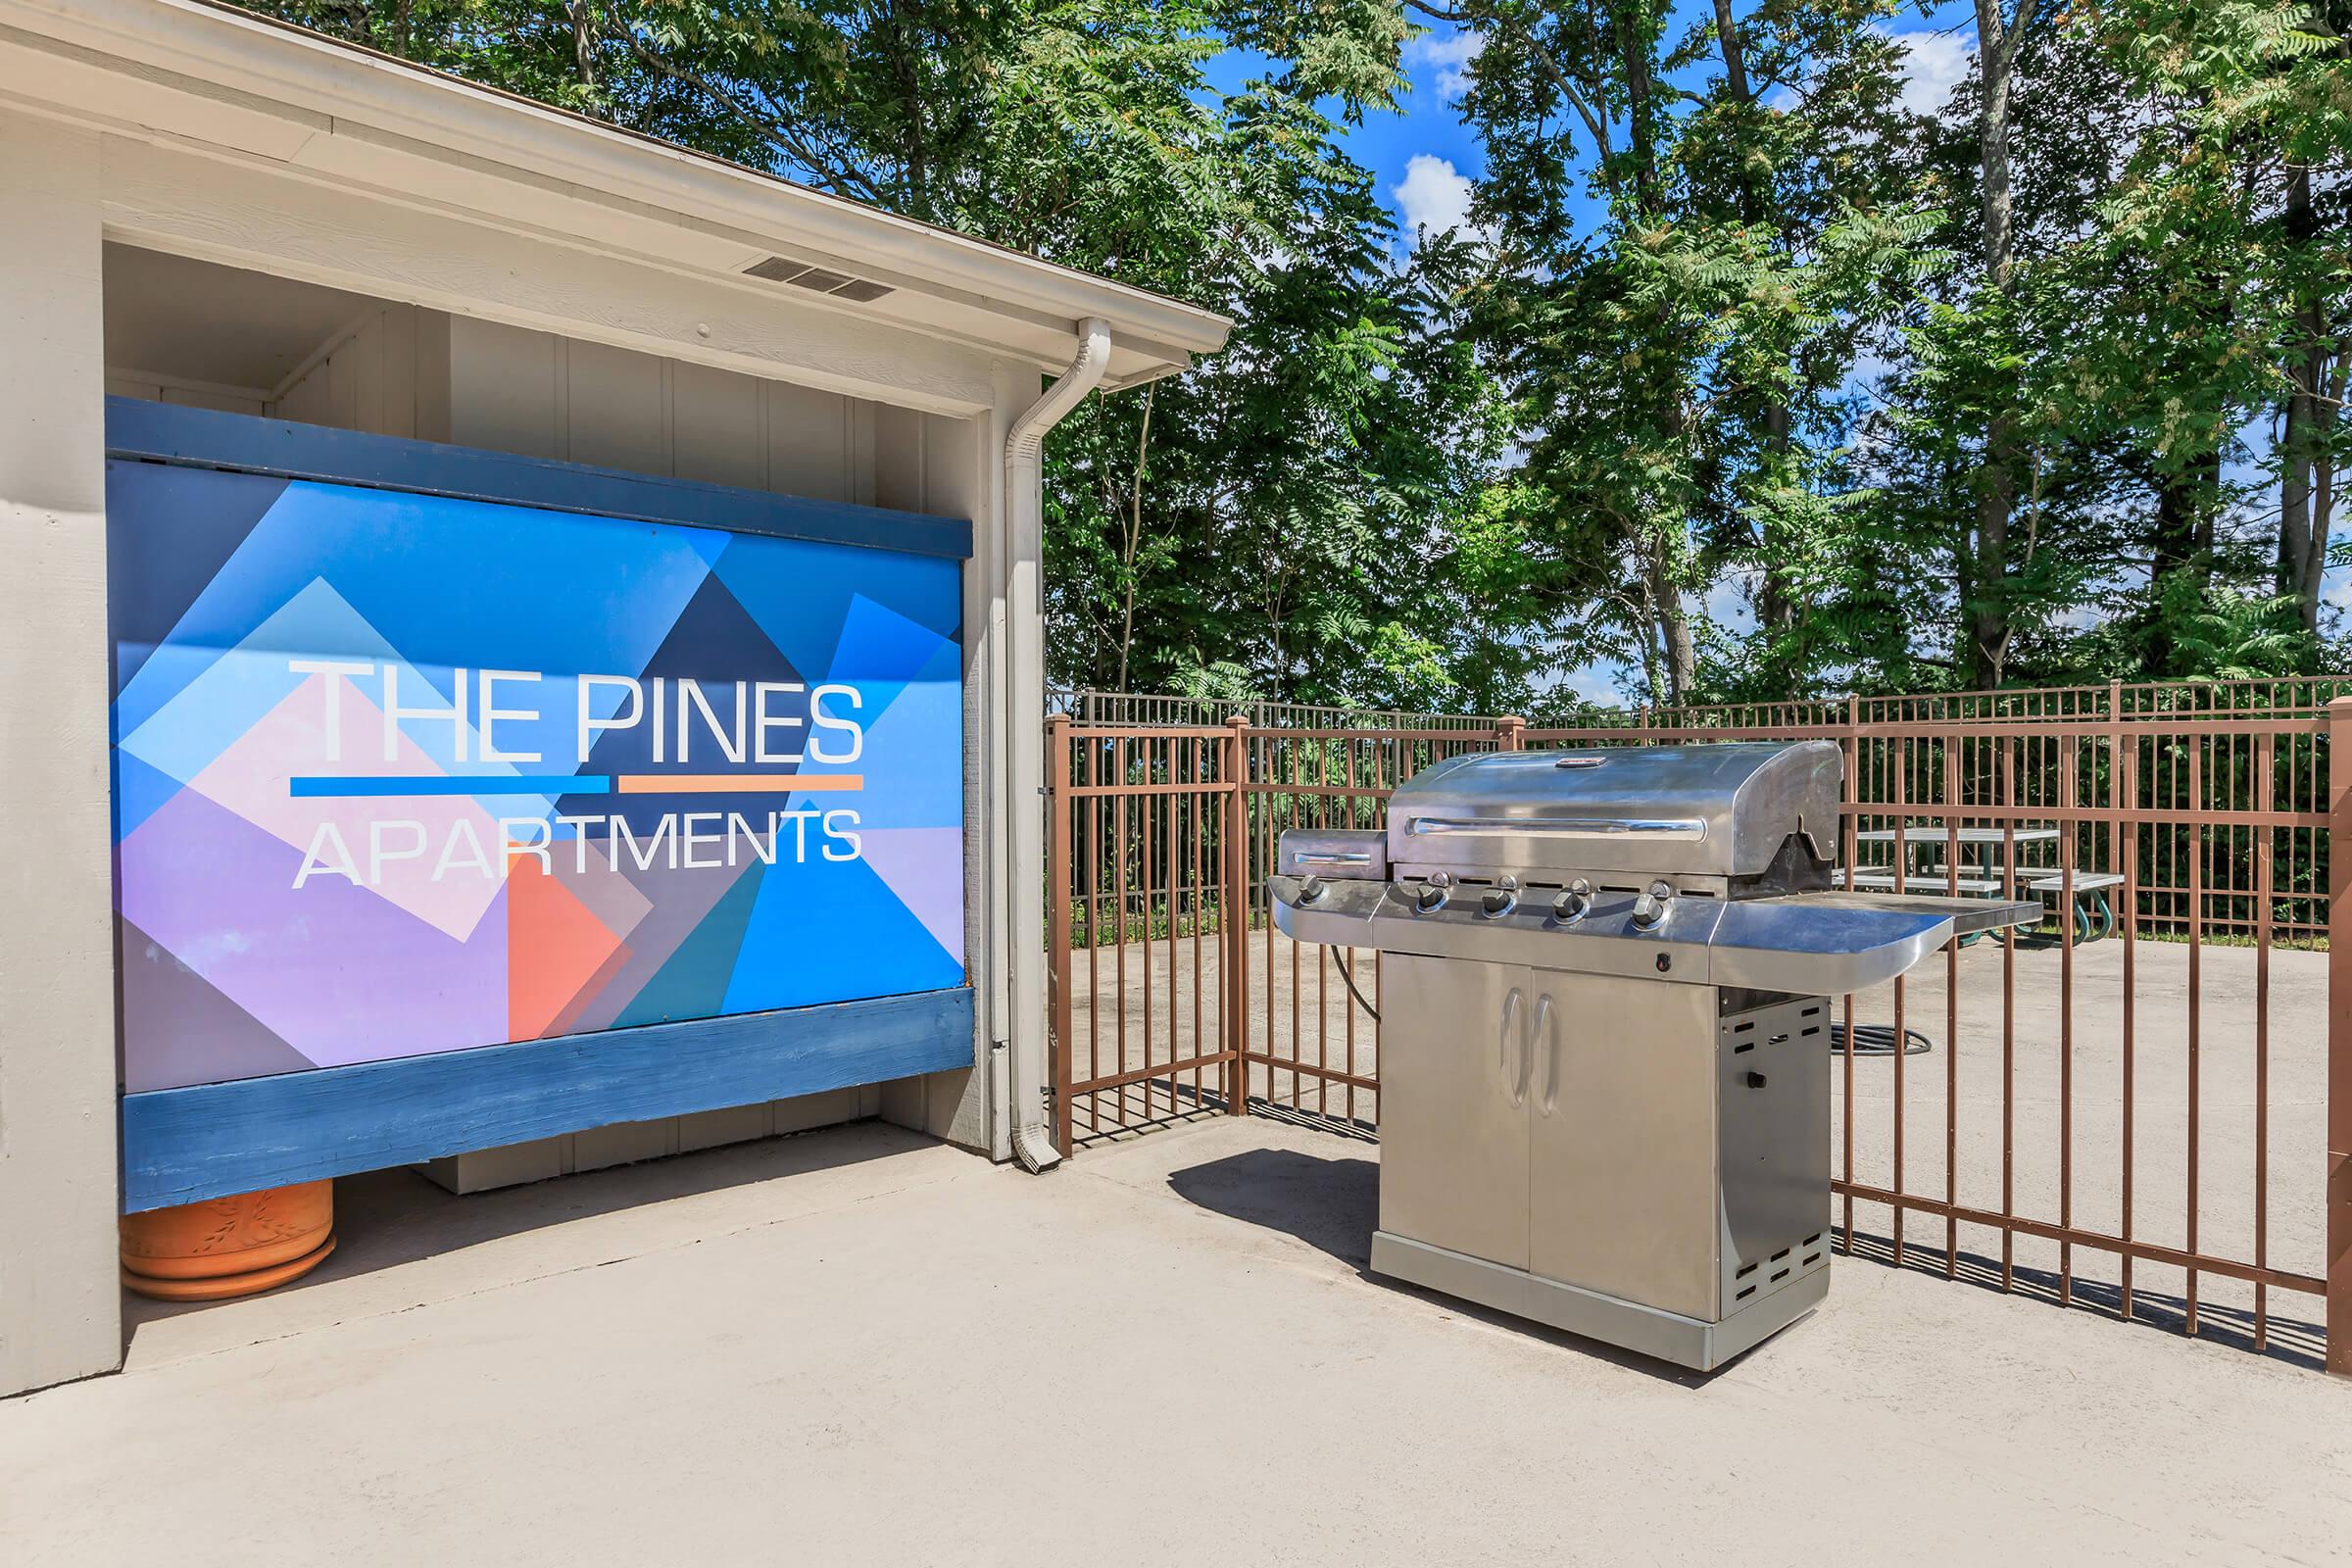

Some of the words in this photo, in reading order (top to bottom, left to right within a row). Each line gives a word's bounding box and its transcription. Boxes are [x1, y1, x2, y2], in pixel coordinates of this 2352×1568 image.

[289, 661, 542, 762] THE
[578, 674, 863, 764] PINES
[291, 809, 862, 890] APARTMENTS
